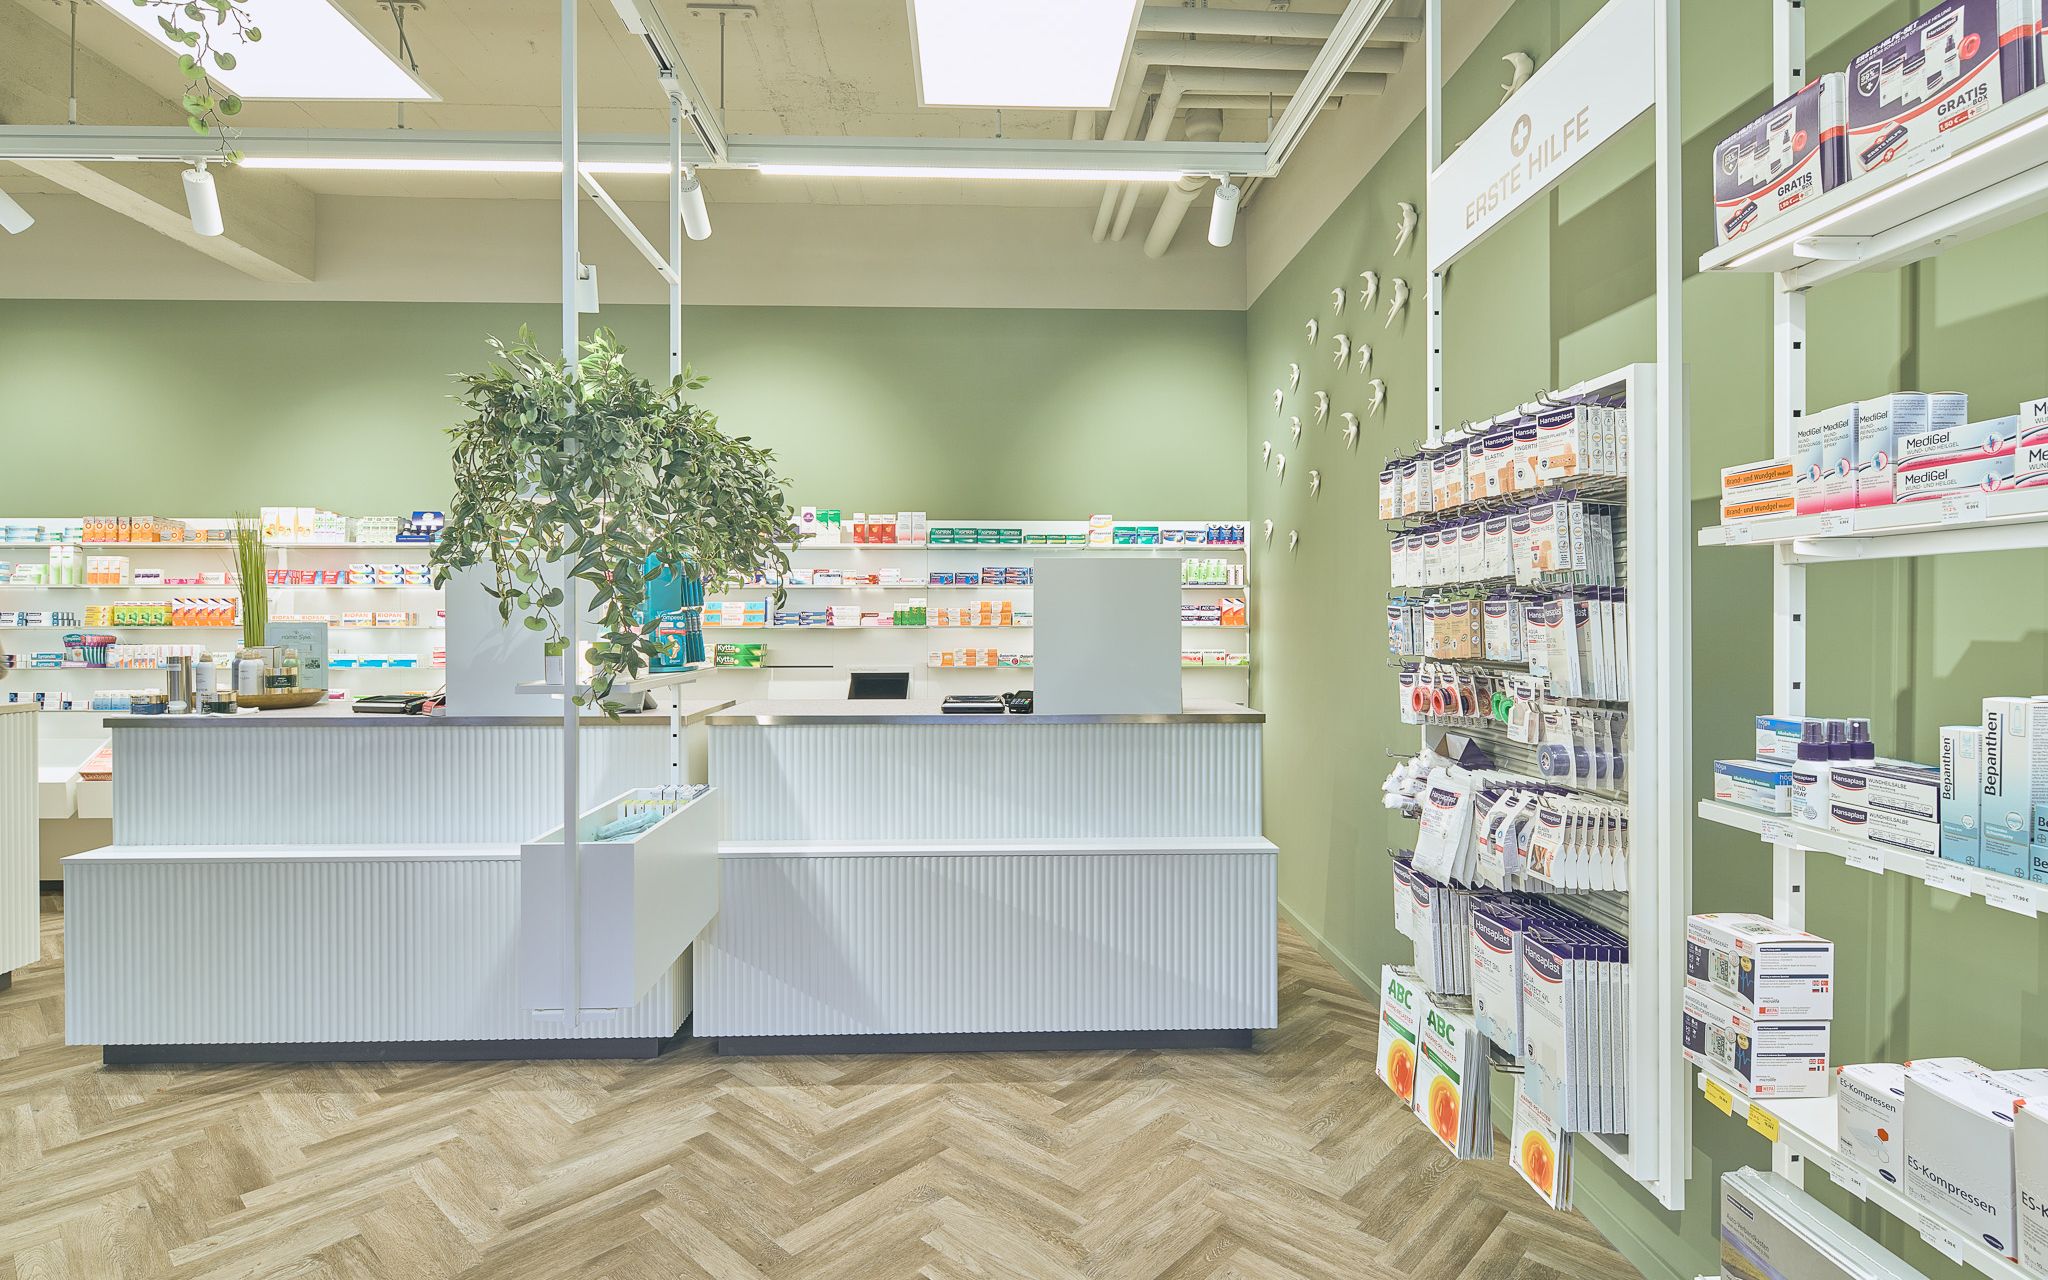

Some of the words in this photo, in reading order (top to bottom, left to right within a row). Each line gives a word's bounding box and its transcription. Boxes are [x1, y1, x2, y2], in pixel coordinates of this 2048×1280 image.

[1937, 83, 1987, 115] GRATIS
[1973, 94, 1987, 105] BOX
[1867, 143, 1886, 158] ERSTE
[1466, 163, 1521, 230] ERSTE
[1528, 105, 1589, 180] HILFE
[1777, 172, 1813, 197] GRATIS
[1540, 412, 1573, 424] Hansaplast
[1860, 410, 1888, 423] MediGel
[1823, 419, 1849, 432] MediGel
[1797, 427, 1822, 438] MediGel
[1906, 432, 1951, 449] MediGel
[1937, 441, 1959, 450] HEILGEL
[1485, 452, 1504, 461] ELASTIC
[1754, 471, 1776, 480] Wundgel
[1905, 469, 1949, 485] MediGel
[1935, 479, 1957, 487] HEILGEL
[1755, 502, 1777, 511] Wundgel
[1984, 711, 1999, 796] Bepanthen
[1942, 737, 1953, 800] Bepanthen
[1833, 774, 1864, 786] Hansaplast
[1868, 778, 1907, 789] WUNDHEILSALBE
[1540, 812, 1560, 823] Hansaplast
[1833, 808, 1865, 820] Hansaplast
[1869, 813, 1909, 826] WUNDHEILSALBE
[1476, 919, 1510, 946] Hansaplast
[1525, 945, 1560, 975] Hansaplast
[1388, 979, 1412, 1009] ABC
[1427, 1009, 1455, 1046] ABC
[1840, 1077, 1897, 1113] ES-Kompressen
[1907, 1155, 1997, 1216] ES-Kompressen
